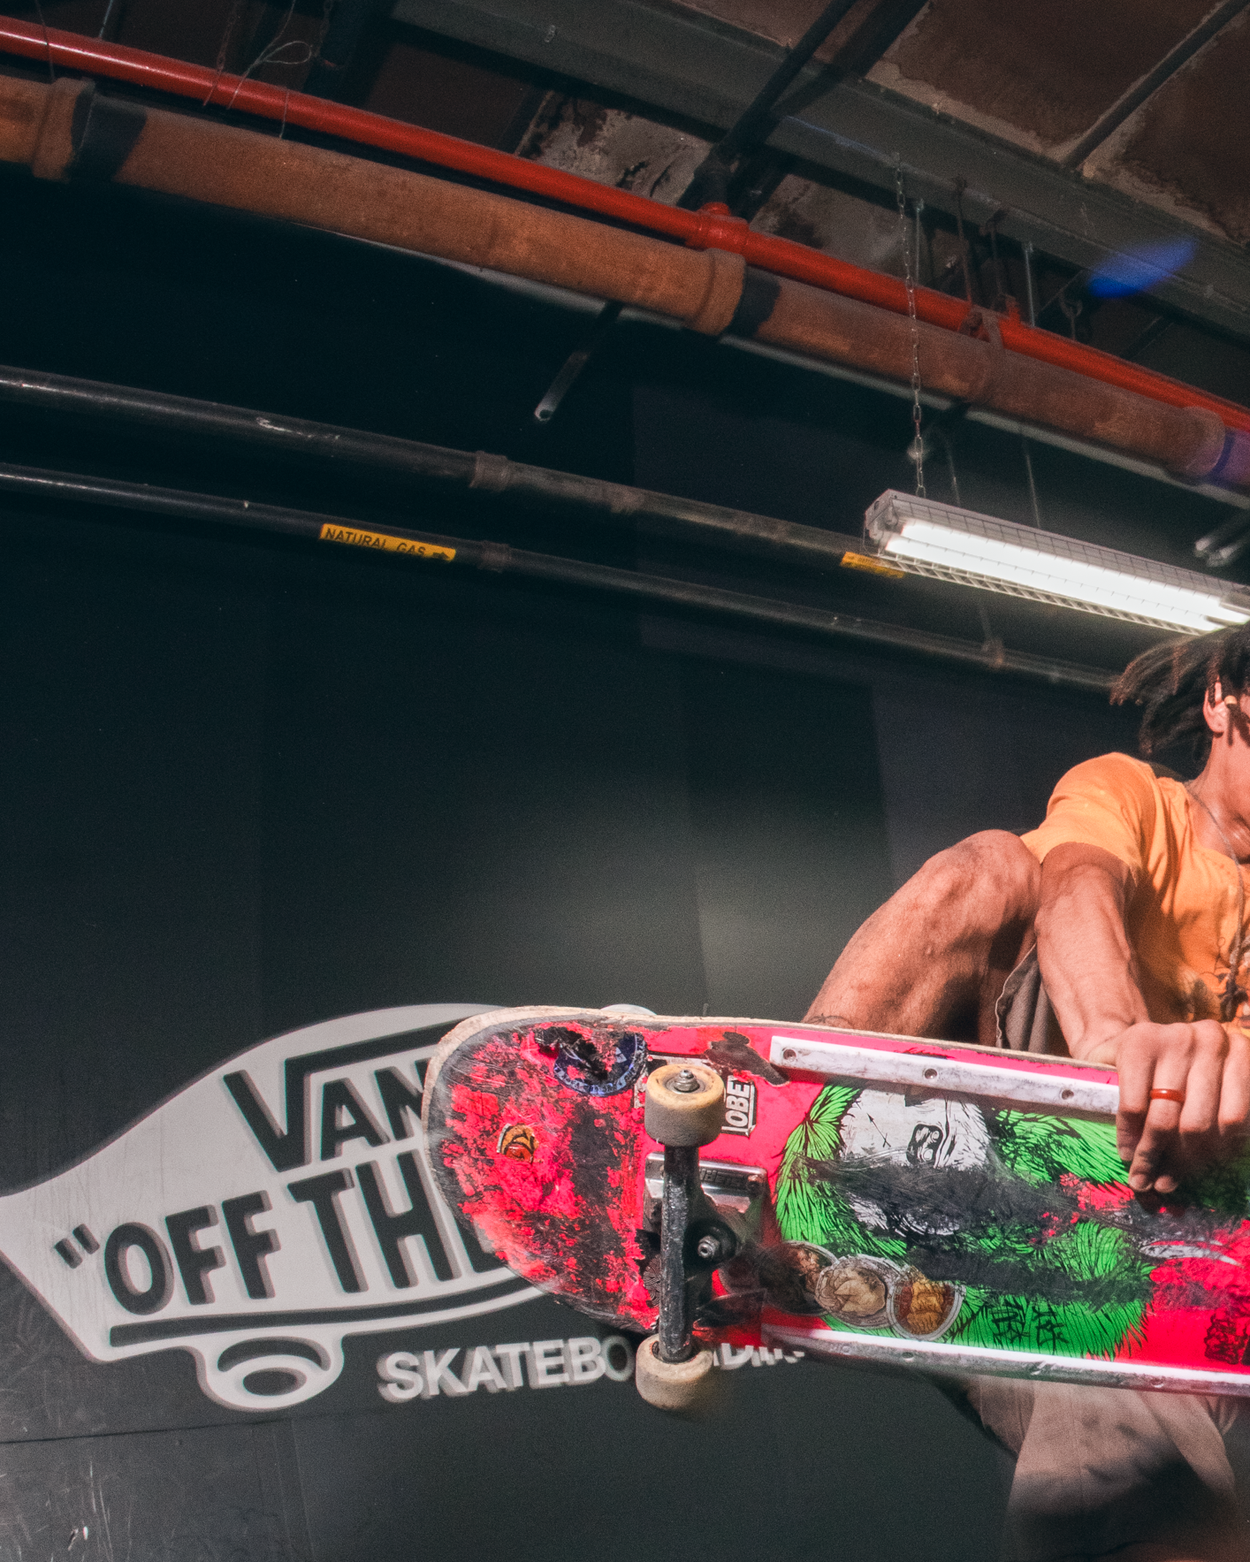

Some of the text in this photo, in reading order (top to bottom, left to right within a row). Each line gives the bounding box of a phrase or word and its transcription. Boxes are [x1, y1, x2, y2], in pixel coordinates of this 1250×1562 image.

[325, 526, 426, 556] NATURAL GAS
[223, 1032, 442, 1174] VAN
